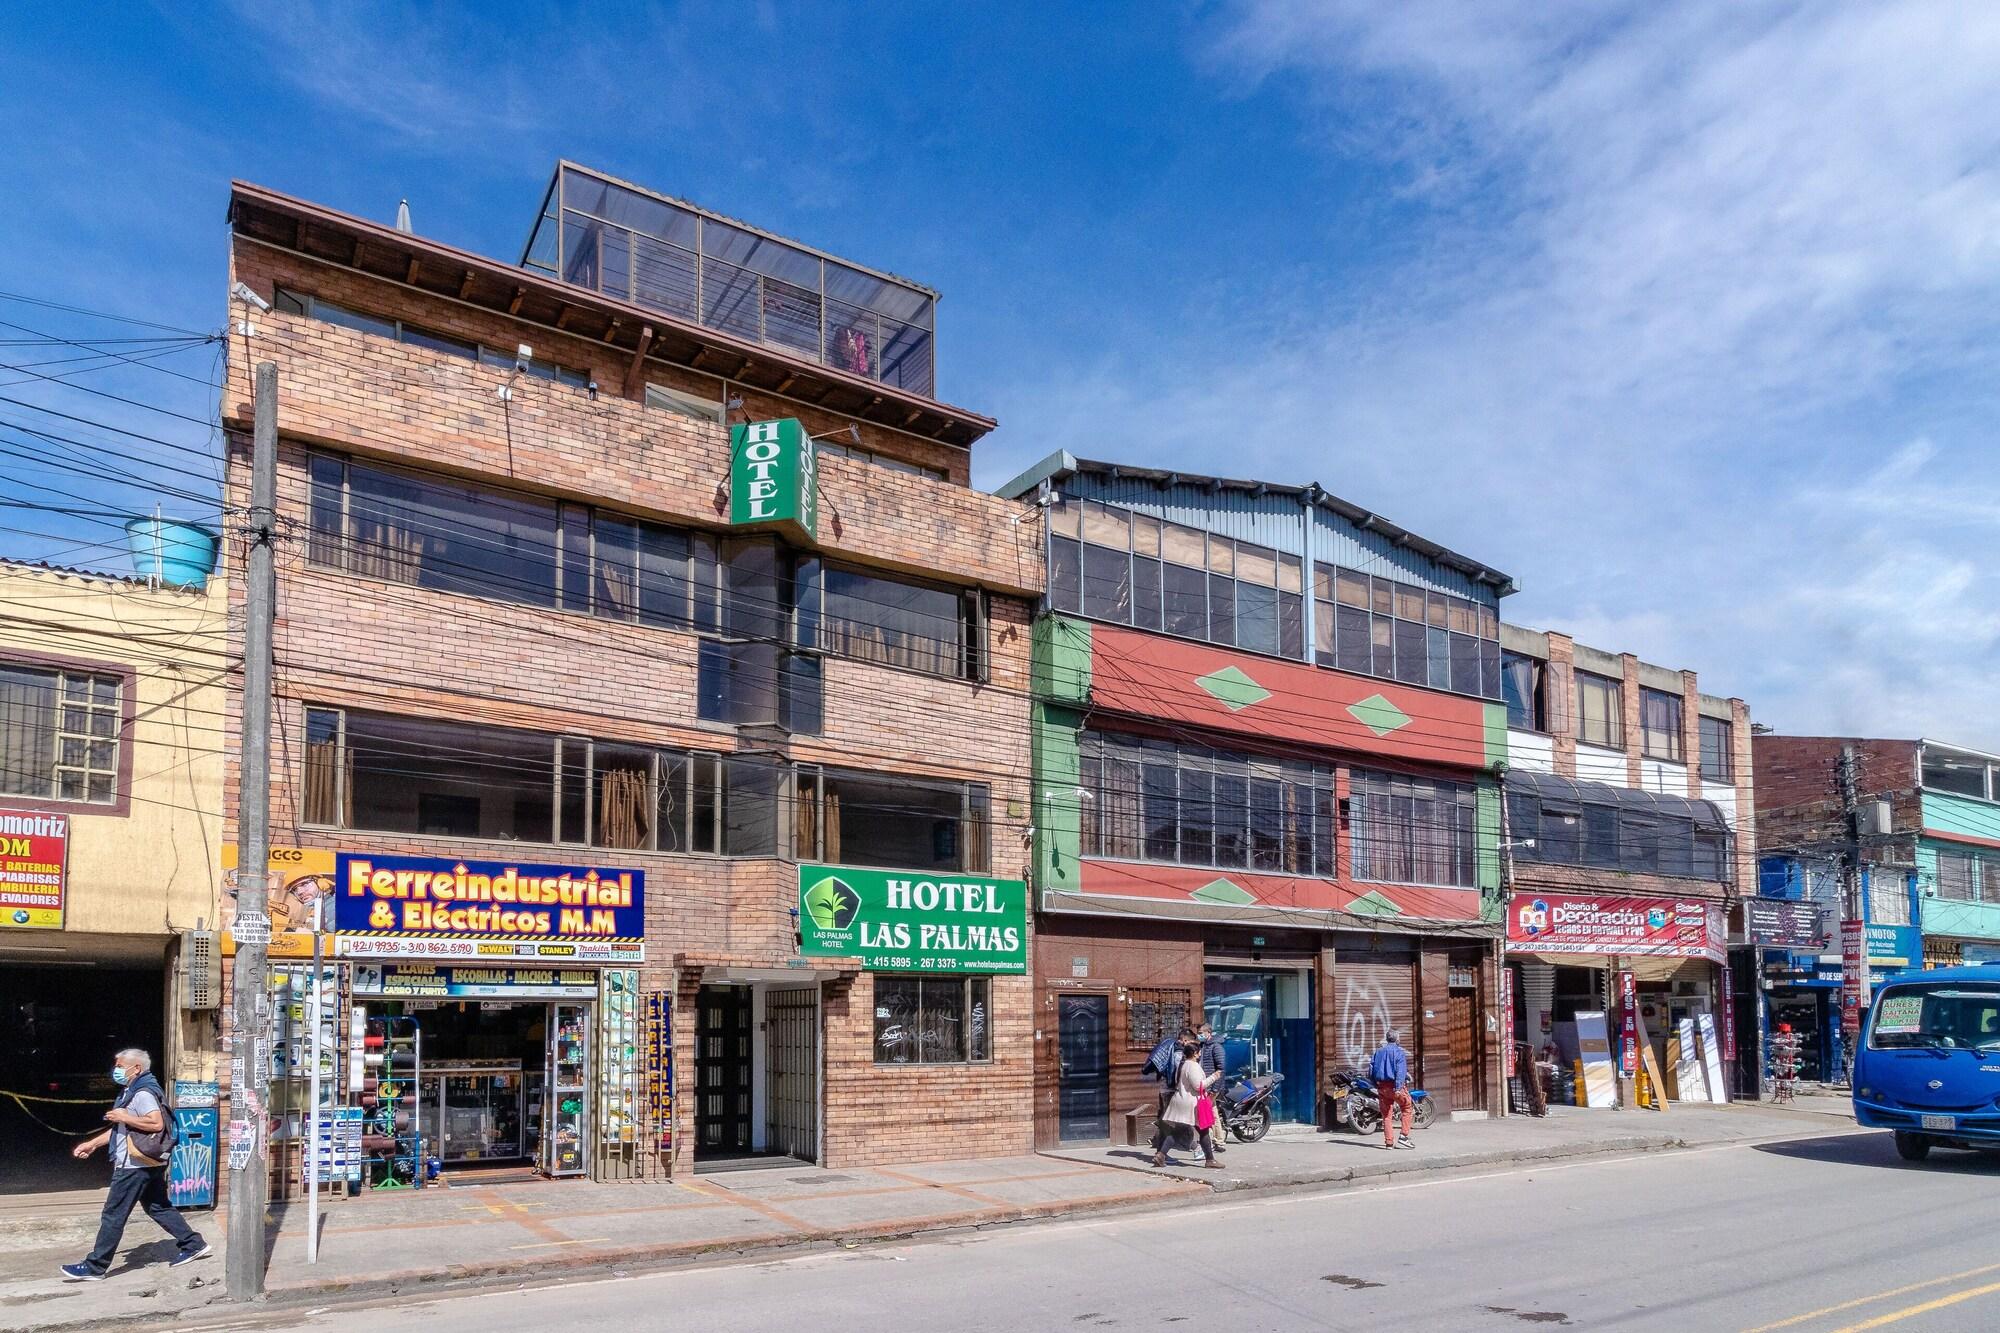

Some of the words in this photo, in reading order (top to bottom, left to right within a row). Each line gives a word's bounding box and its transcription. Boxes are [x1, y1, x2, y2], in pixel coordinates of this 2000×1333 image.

[746, 422, 780, 519] HOTEL
[800, 428, 814, 532] HOTEL
[0, 815, 64, 837] motriz
[6, 862, 60, 874] BATERIAS
[348, 860, 633, 907] Ferreindustrial
[0, 894, 59, 906] EVADORES
[886, 880, 1006, 914] HOTEL
[1563, 902, 1590, 911] Diseño
[1591, 902, 1599, 911] &
[368, 900, 396, 930] &
[402, 901, 551, 934] Eléctricos
[559, 908, 617, 936] M.M
[1552, 907, 1645, 925] Decoración
[813, 931, 827, 939] LAS
[827, 932, 853, 940] PALMAS
[860, 922, 911, 949] LAS
[919, 924, 1020, 952] PALMAS
[1554, 924, 1581, 934] TECHOS
[1583, 924, 1592, 934] EN
[1630, 926, 1645, 936] PVC
[352, 941, 373, 950] 421
[374, 941, 400, 951] 9935
[408, 942, 427, 953] 310
[428, 943, 448, 953] 862
[450, 943, 474, 954] 5190
[539, 945, 575, 956] STANLEY
[822, 940, 844, 948] HOTEL
[1687, 947, 1702, 955] VISA
[873, 956, 889, 967] 415
[891, 957, 911, 968] 5895
[920, 958, 937, 968] 267
[937, 958, 957, 968] 3375
[384, 974, 446, 986] ESPECIALES
[452, 968, 507, 984] ESCOBILLAS
[514, 970, 553, 984] MACHOS
[1624, 974, 1634, 1010] PISOS
[1625, 1016, 1634, 1031] EN
